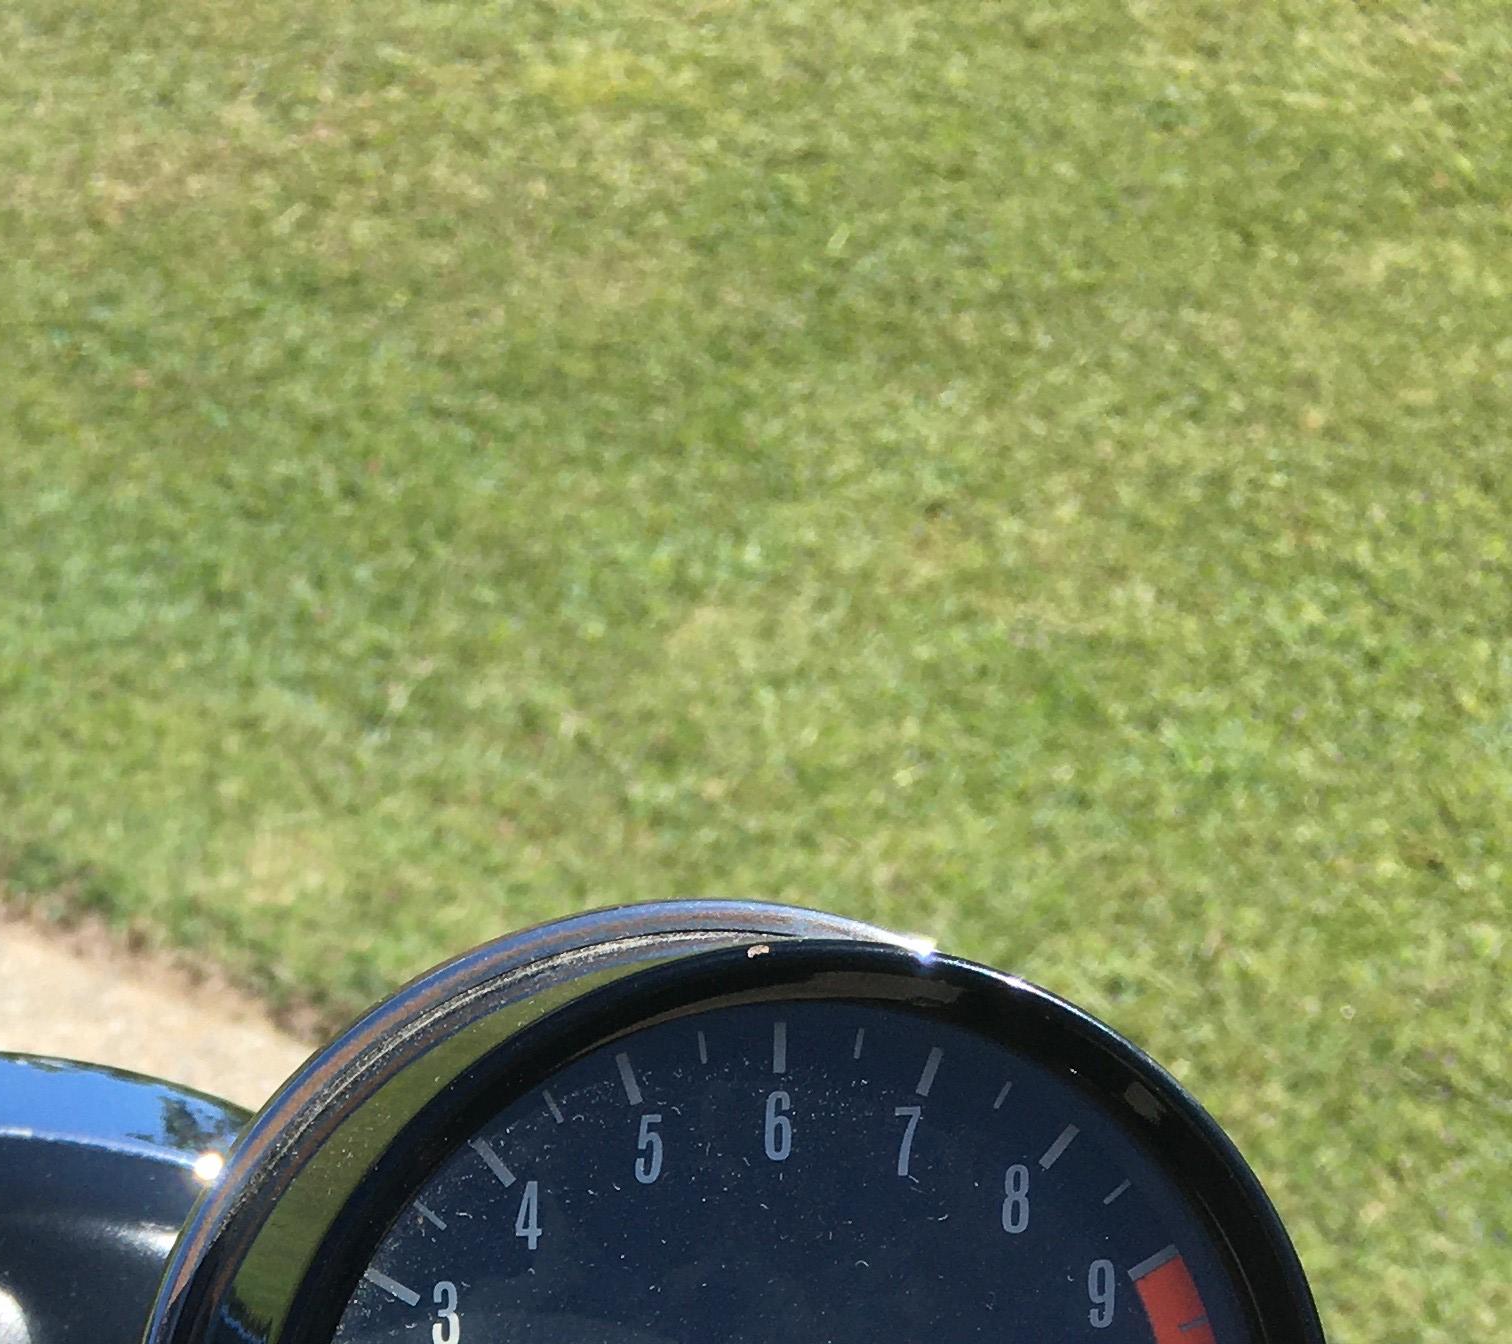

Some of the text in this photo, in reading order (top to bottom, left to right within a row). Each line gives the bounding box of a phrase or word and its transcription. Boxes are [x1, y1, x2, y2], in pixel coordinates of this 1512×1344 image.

[634, 1114, 664, 1185] 5
[764, 1090, 792, 1161] 6
[892, 1105, 924, 1177] 7
[514, 1180, 542, 1250] 4
[1000, 1164, 1031, 1234] 8
[1086, 1258, 1117, 1329] 9
